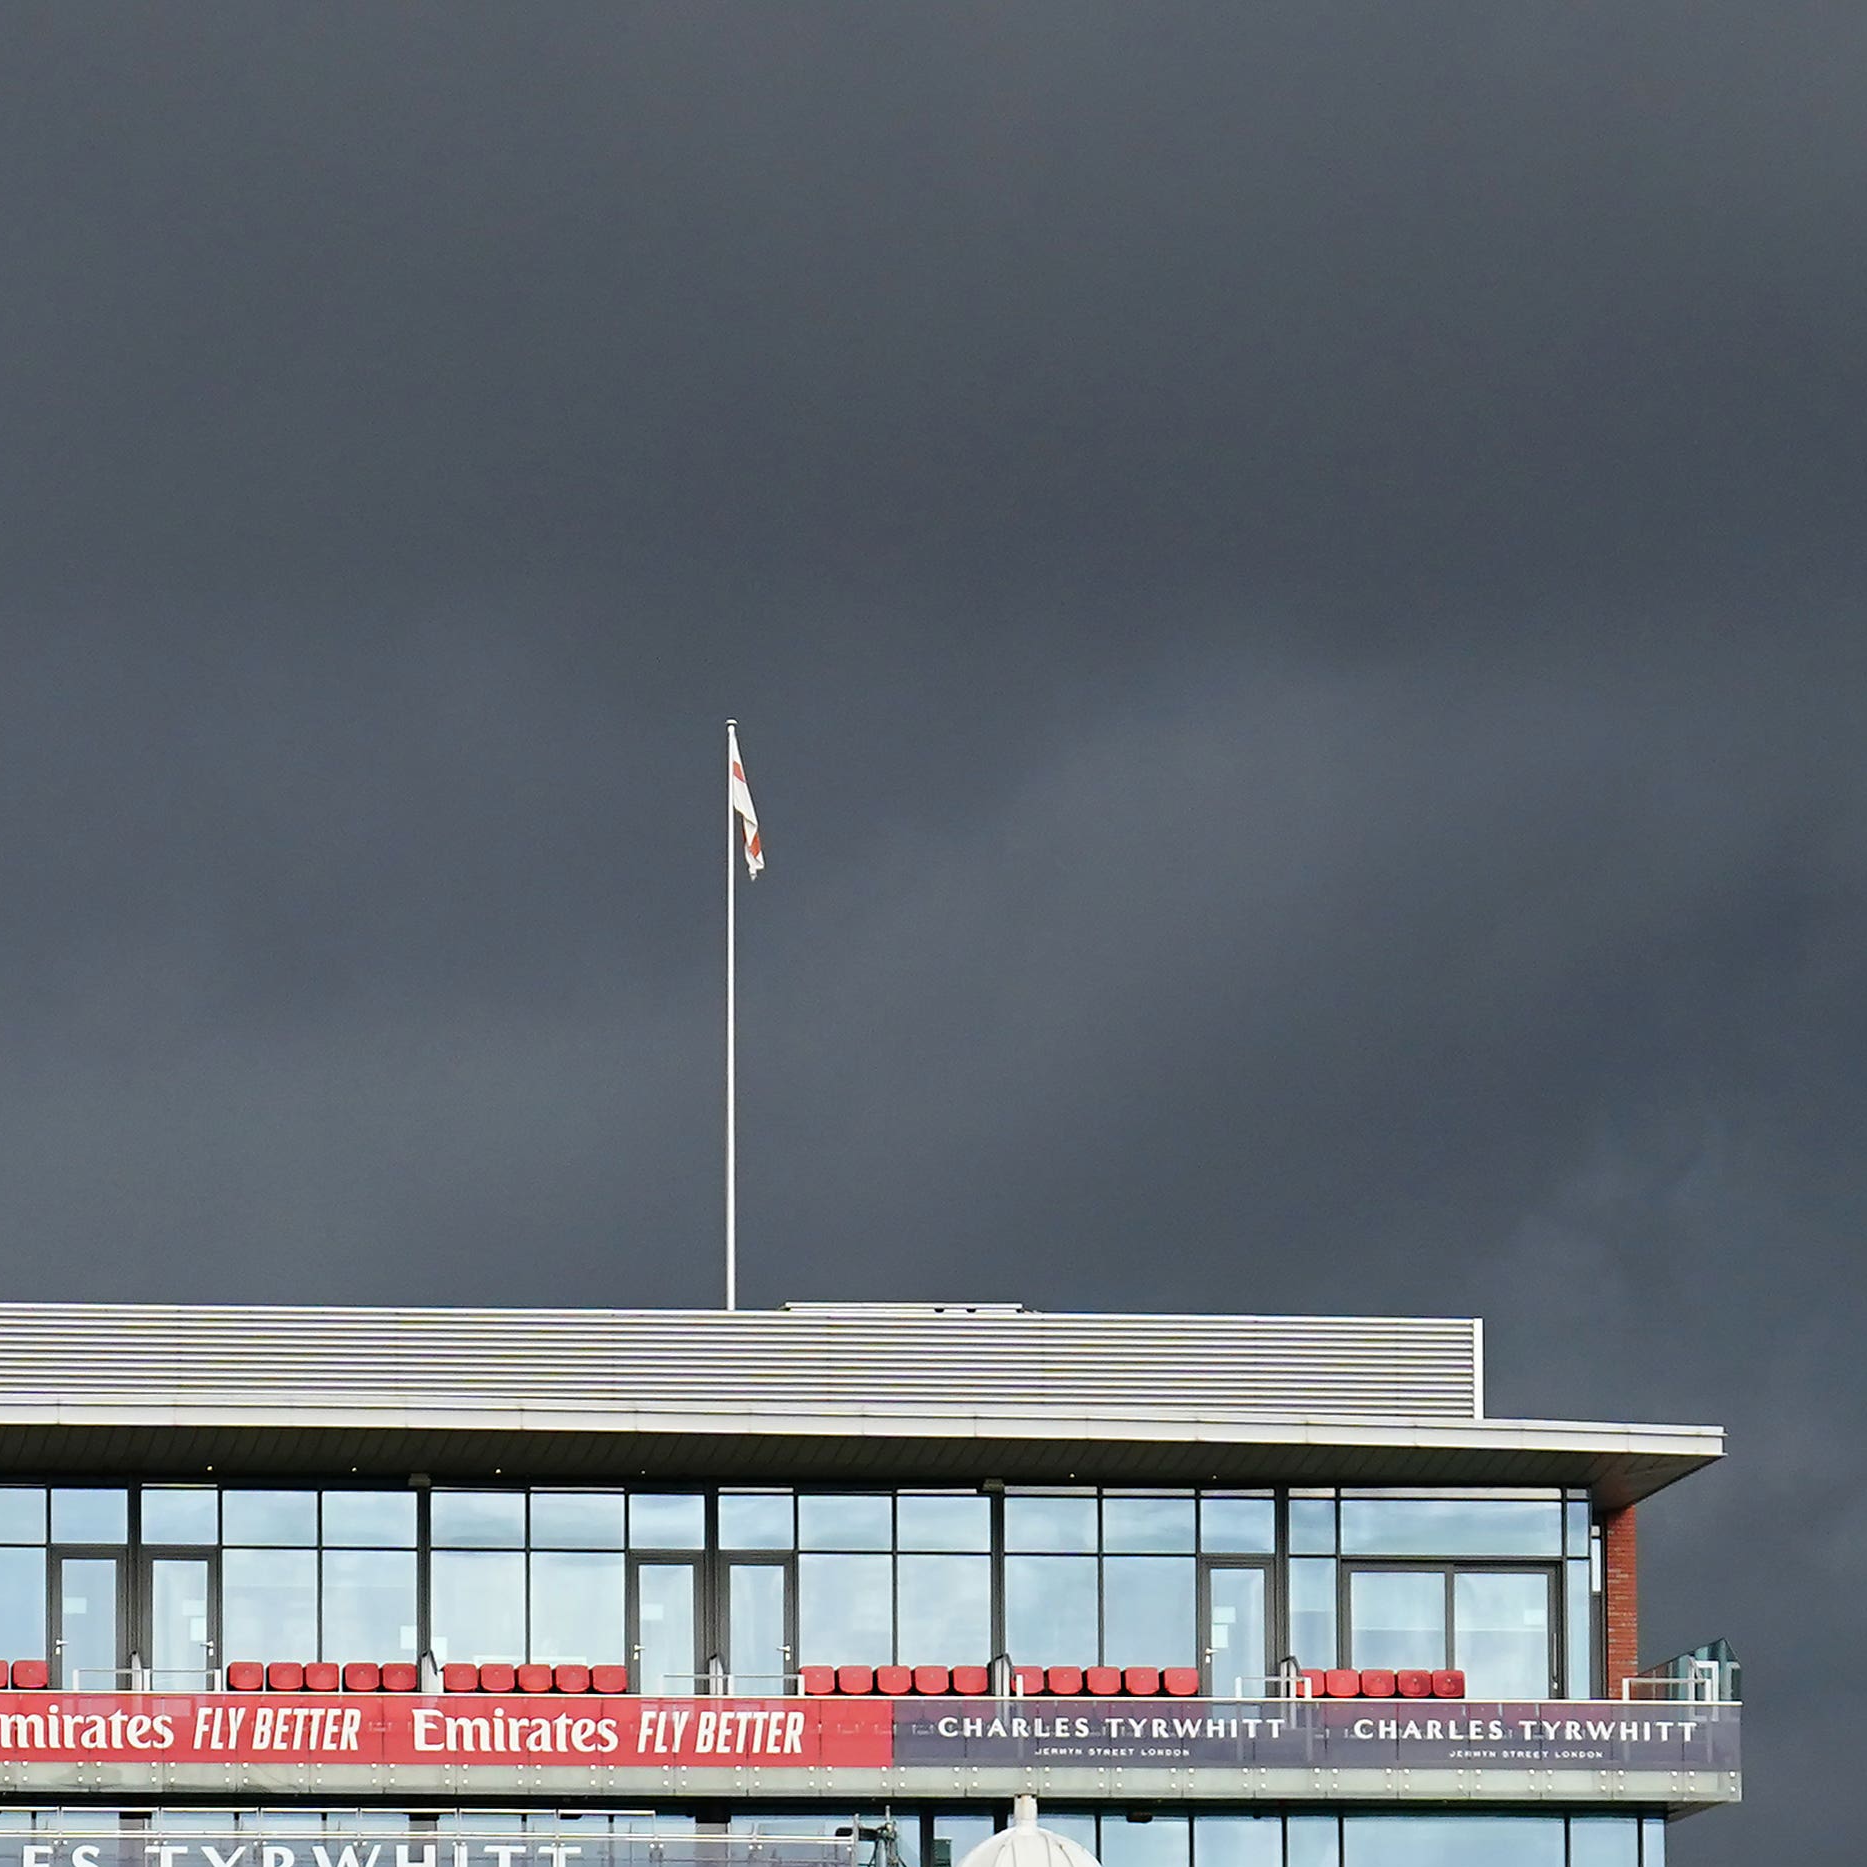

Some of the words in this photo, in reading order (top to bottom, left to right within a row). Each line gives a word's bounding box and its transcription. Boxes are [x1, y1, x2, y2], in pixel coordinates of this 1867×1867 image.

[192, 1707, 247, 1750] FLY
[251, 1708, 361, 1751] BETTER
[412, 1708, 619, 1753] Emirates
[636, 1711, 689, 1754] FLY
[694, 1711, 804, 1755] BETTER
[937, 1716, 1091, 1739] CHARLES
[1107, 1717, 1287, 1739] TYRWHITT
[1353, 1718, 1504, 1742] CHARLES
[1517, 1720, 1699, 1743] TYRWHITT
[1034, 1747, 1083, 1757] JERMYN
[1087, 1748, 1135, 1757] STREET
[1140, 1748, 1190, 1757] LONDON
[1448, 1749, 1497, 1759] JERMYN
[1501, 1750, 1549, 1760] STREET
[1554, 1750, 1603, 1759] LONDON
